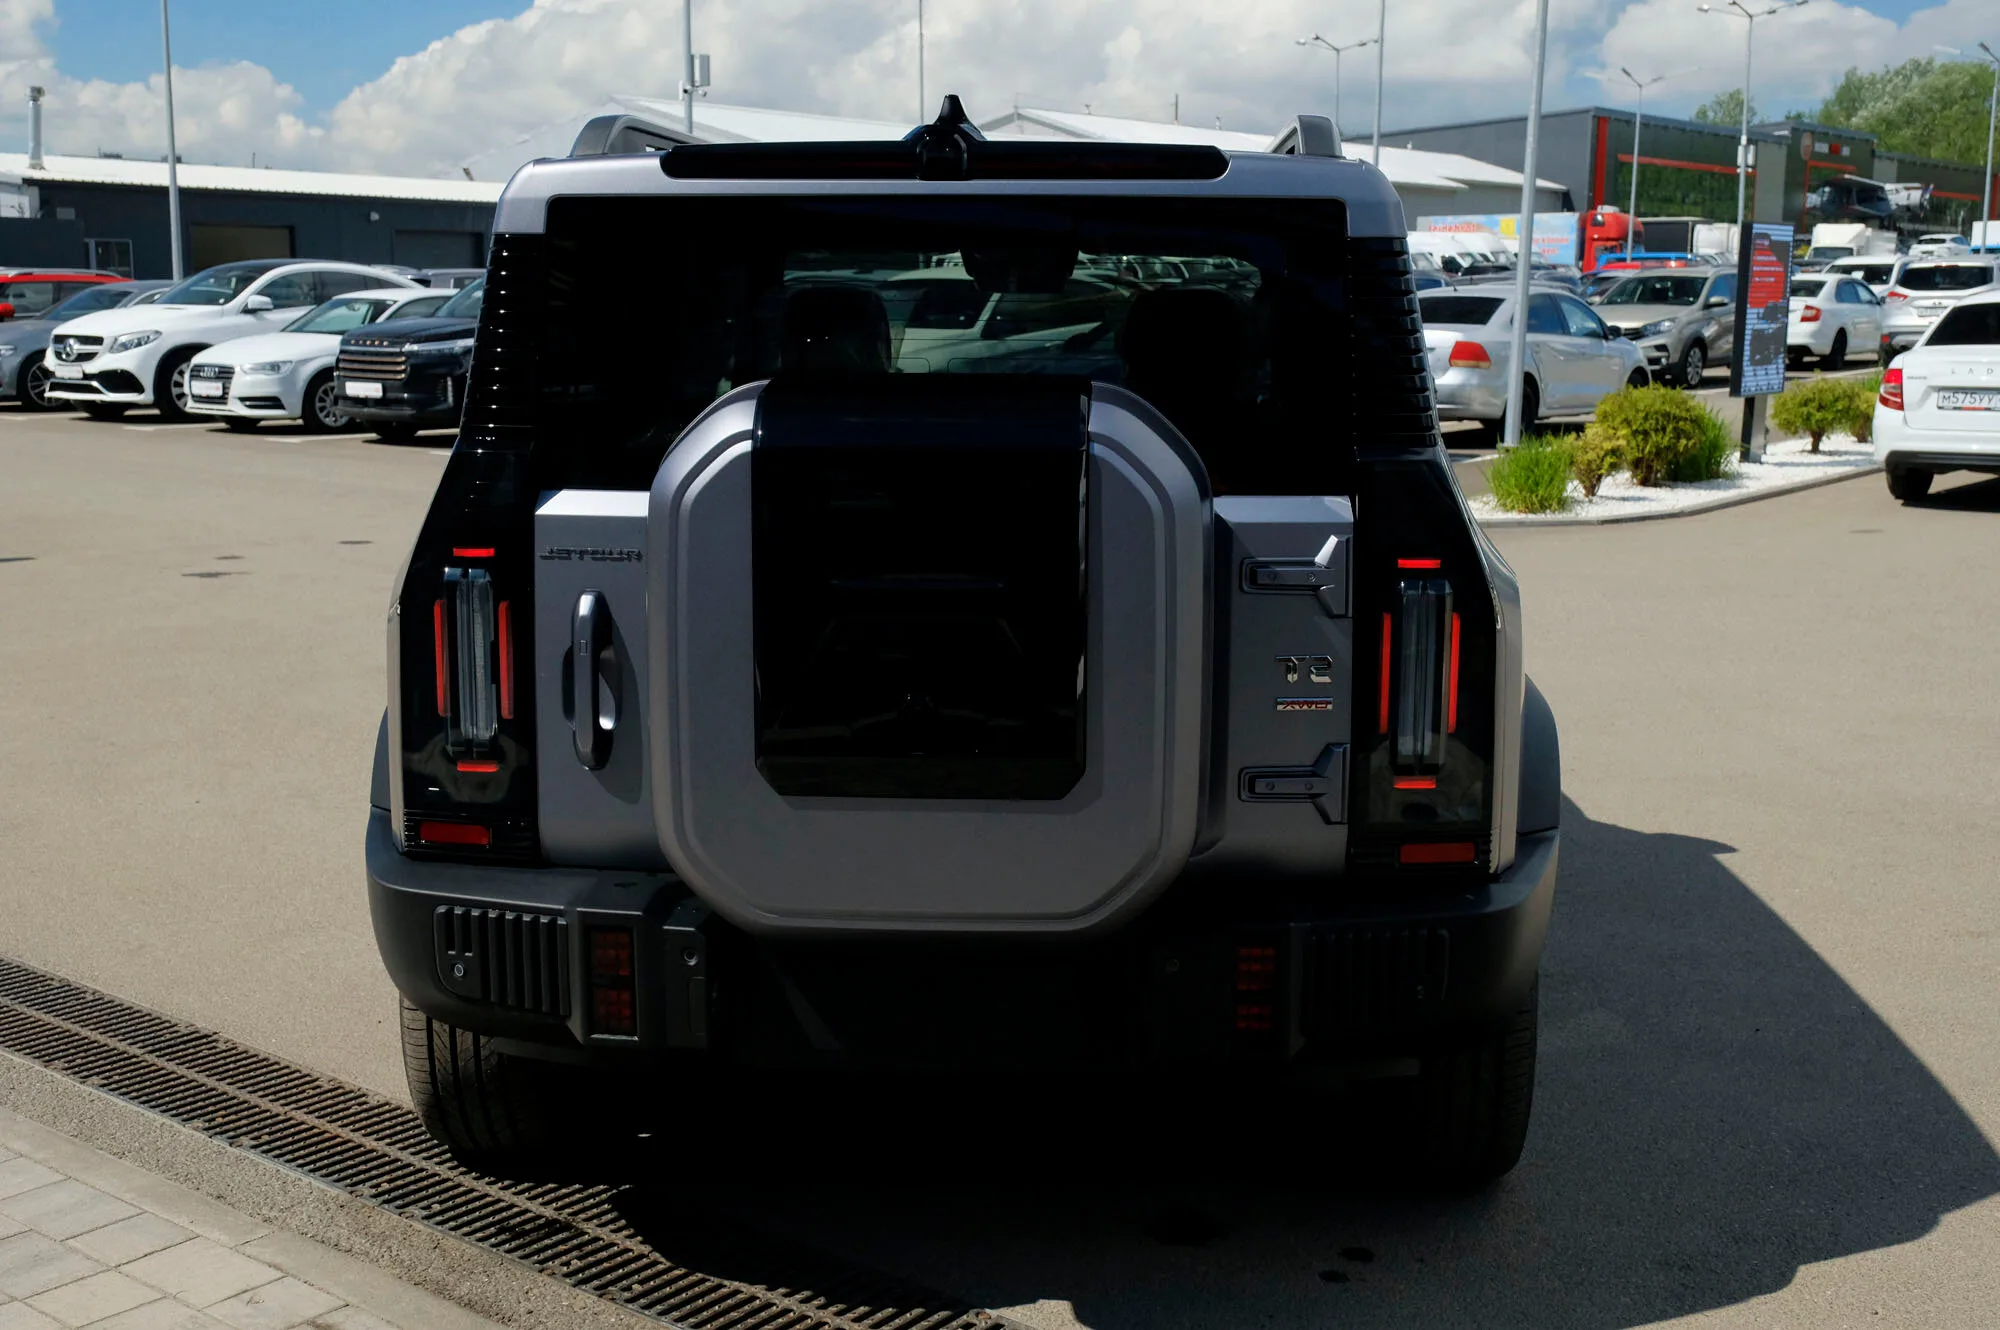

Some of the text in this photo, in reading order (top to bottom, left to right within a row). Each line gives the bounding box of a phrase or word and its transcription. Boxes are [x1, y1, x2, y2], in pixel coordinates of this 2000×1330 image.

[539, 547, 643, 562] JETOUR
[1275, 655, 1333, 684] T2
[1280, 699, 1331, 710] XWD
